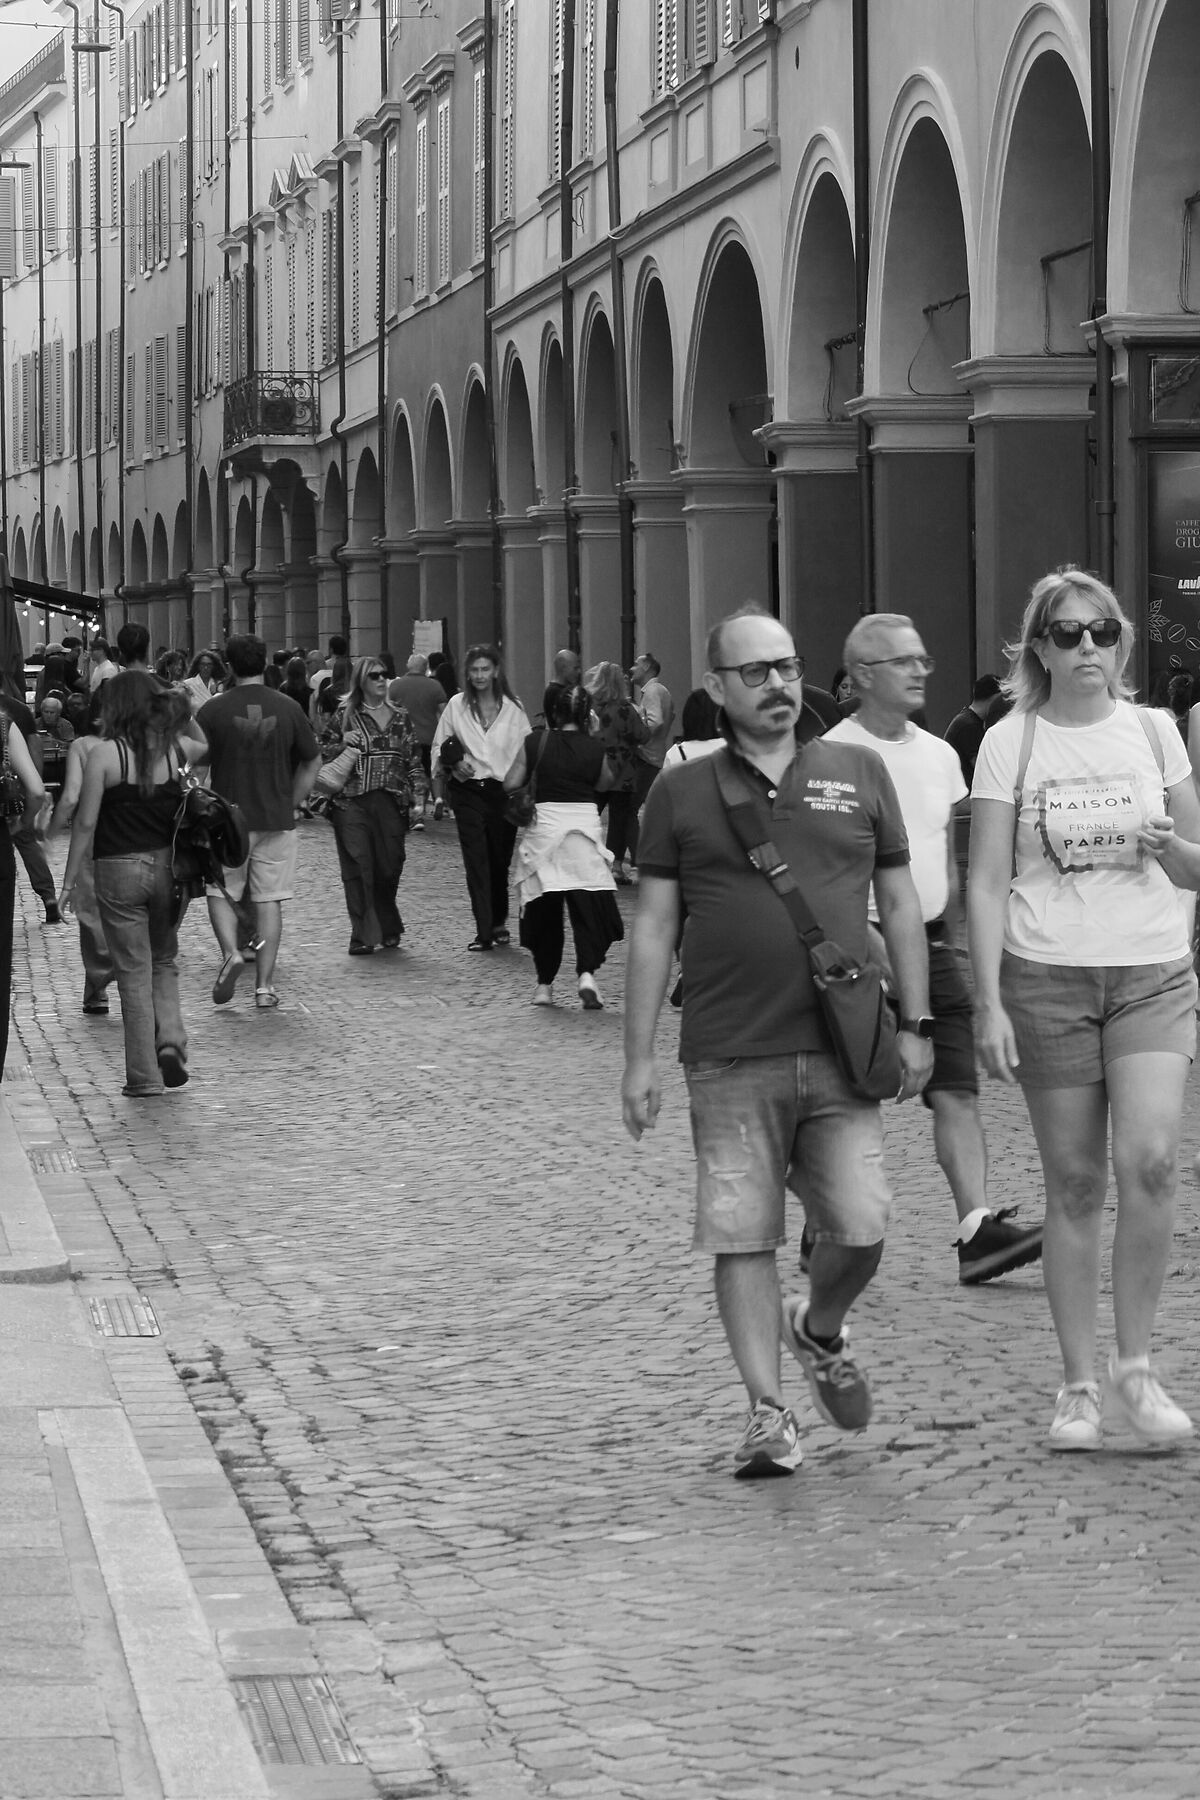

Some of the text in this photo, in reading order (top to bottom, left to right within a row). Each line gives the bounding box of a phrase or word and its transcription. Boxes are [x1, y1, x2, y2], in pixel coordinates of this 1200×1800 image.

[1049, 796, 1132, 810] MAISON
[1068, 821, 1120, 832] FRANCE
[1063, 834, 1126, 850] PARIS
